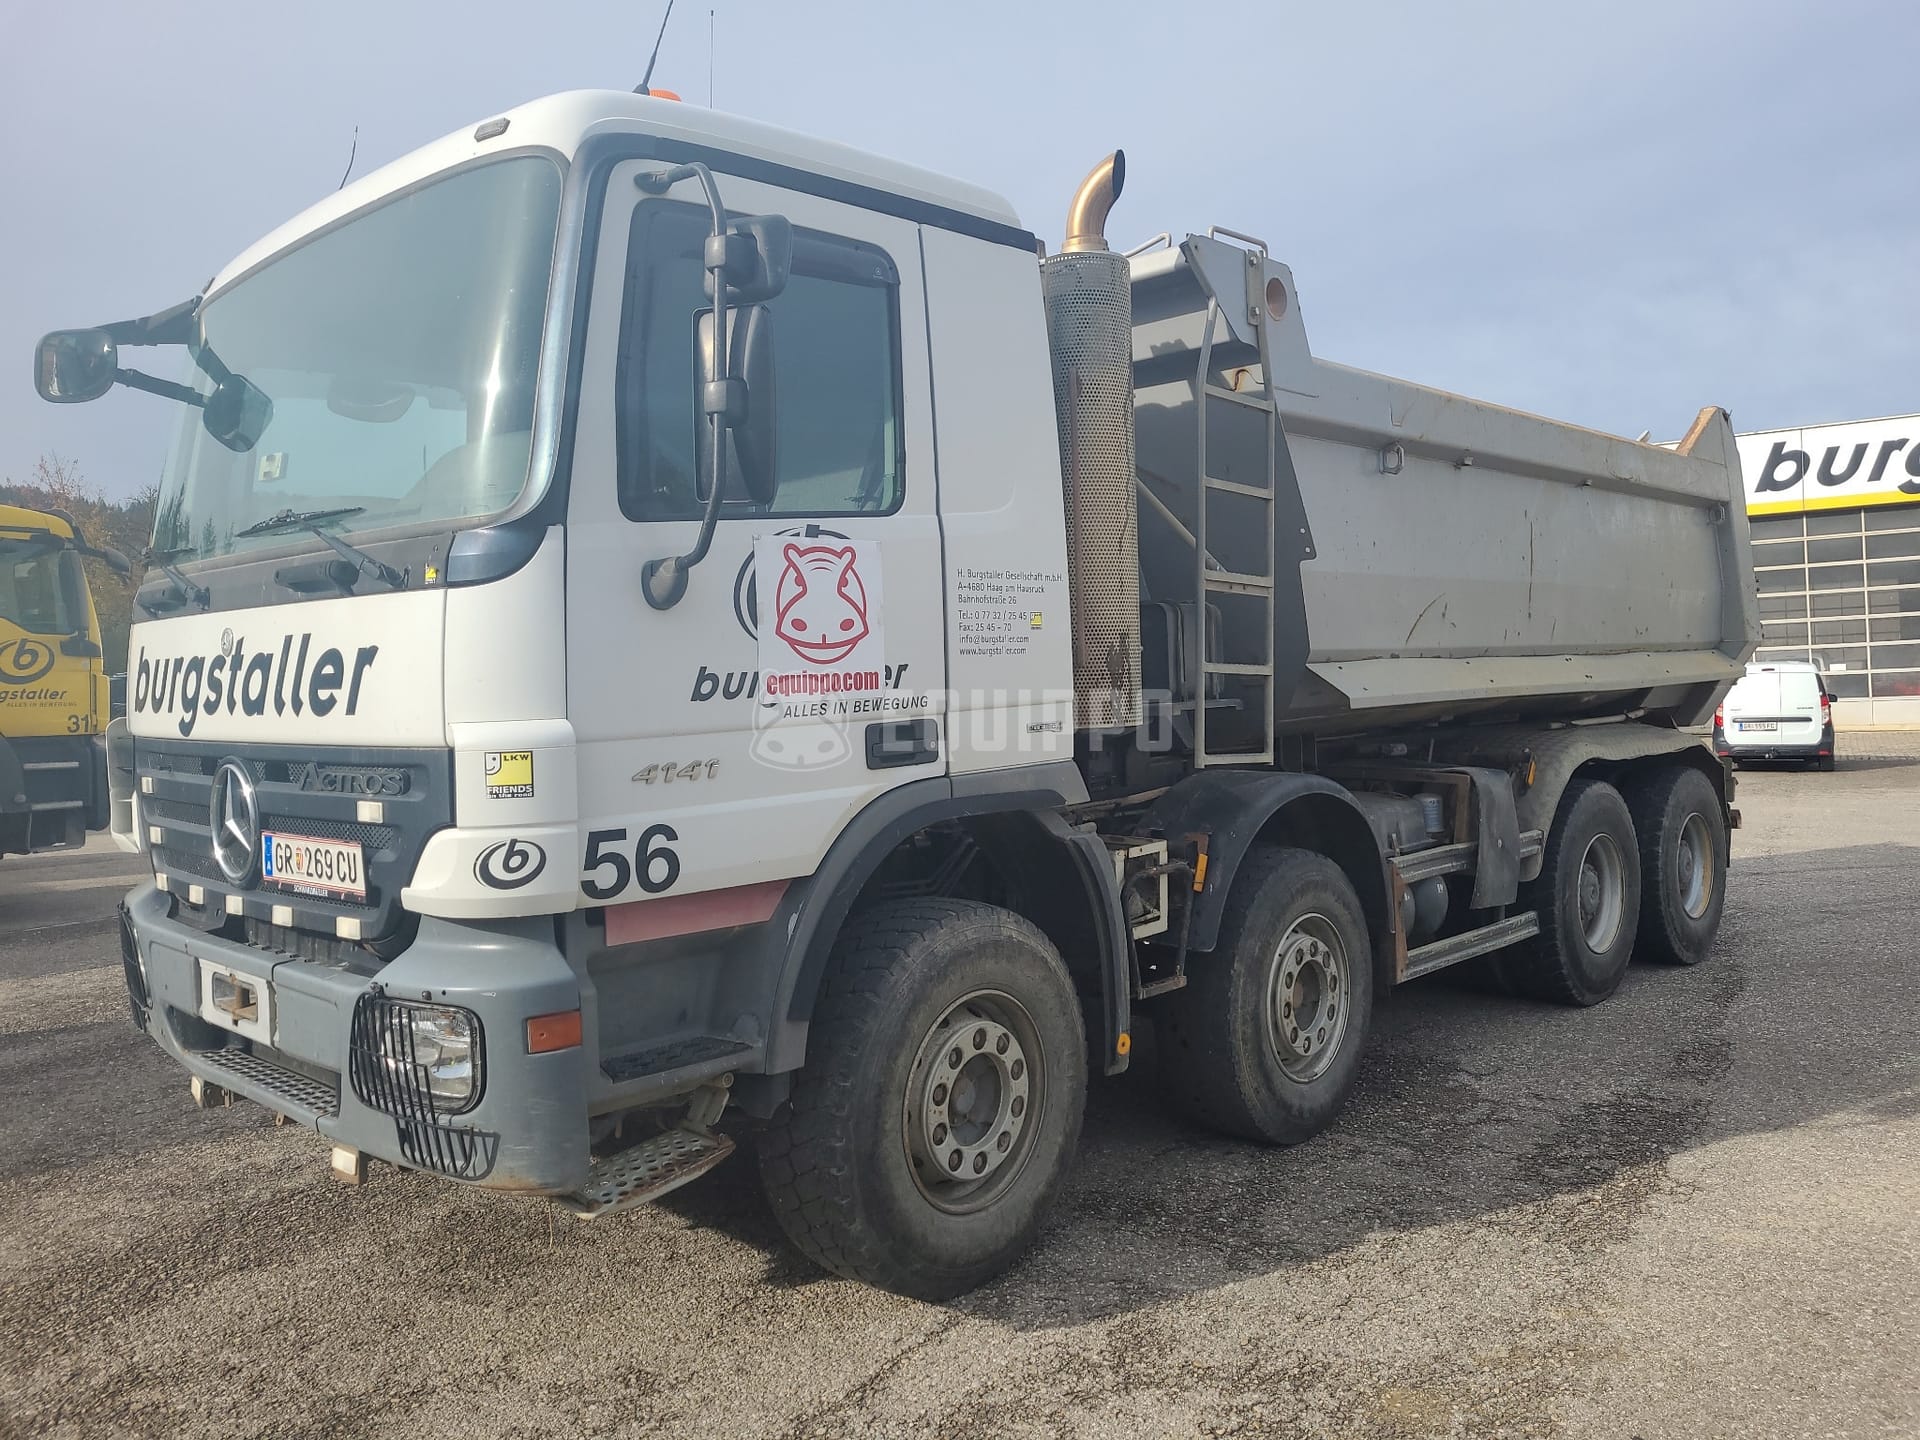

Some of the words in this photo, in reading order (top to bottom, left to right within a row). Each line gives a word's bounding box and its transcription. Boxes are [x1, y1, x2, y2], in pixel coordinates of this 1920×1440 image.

[967, 569, 1004, 580] Burgstaller
[957, 582, 985, 592] A-4680
[986, 582, 1003, 594] Haag
[1008, 596, 1017, 605] 26
[981, 611, 990, 620] 77
[1008, 611, 1017, 620] 25
[1018, 612, 1028, 620] 45
[959, 622, 974, 632] Fax:
[975, 623, 985, 632] 25
[986, 623, 996, 632] 45
[1003, 623, 1012, 632] 70
[134, 633, 379, 737] burgstaller
[766, 670, 880, 696] equippo.com
[784, 703, 827, 718] ALLES
[833, 701, 848, 714] IN
[853, 696, 928, 713] BEWEGUNG
[67, 714, 89, 733] 31
[632, 759, 719, 785] 4141
[487, 785, 533, 793] FRIENDS
[275, 842, 294, 875] GR
[305, 847, 333, 880] 269
[336, 850, 358, 884] CU
[580, 824, 681, 900] 56
